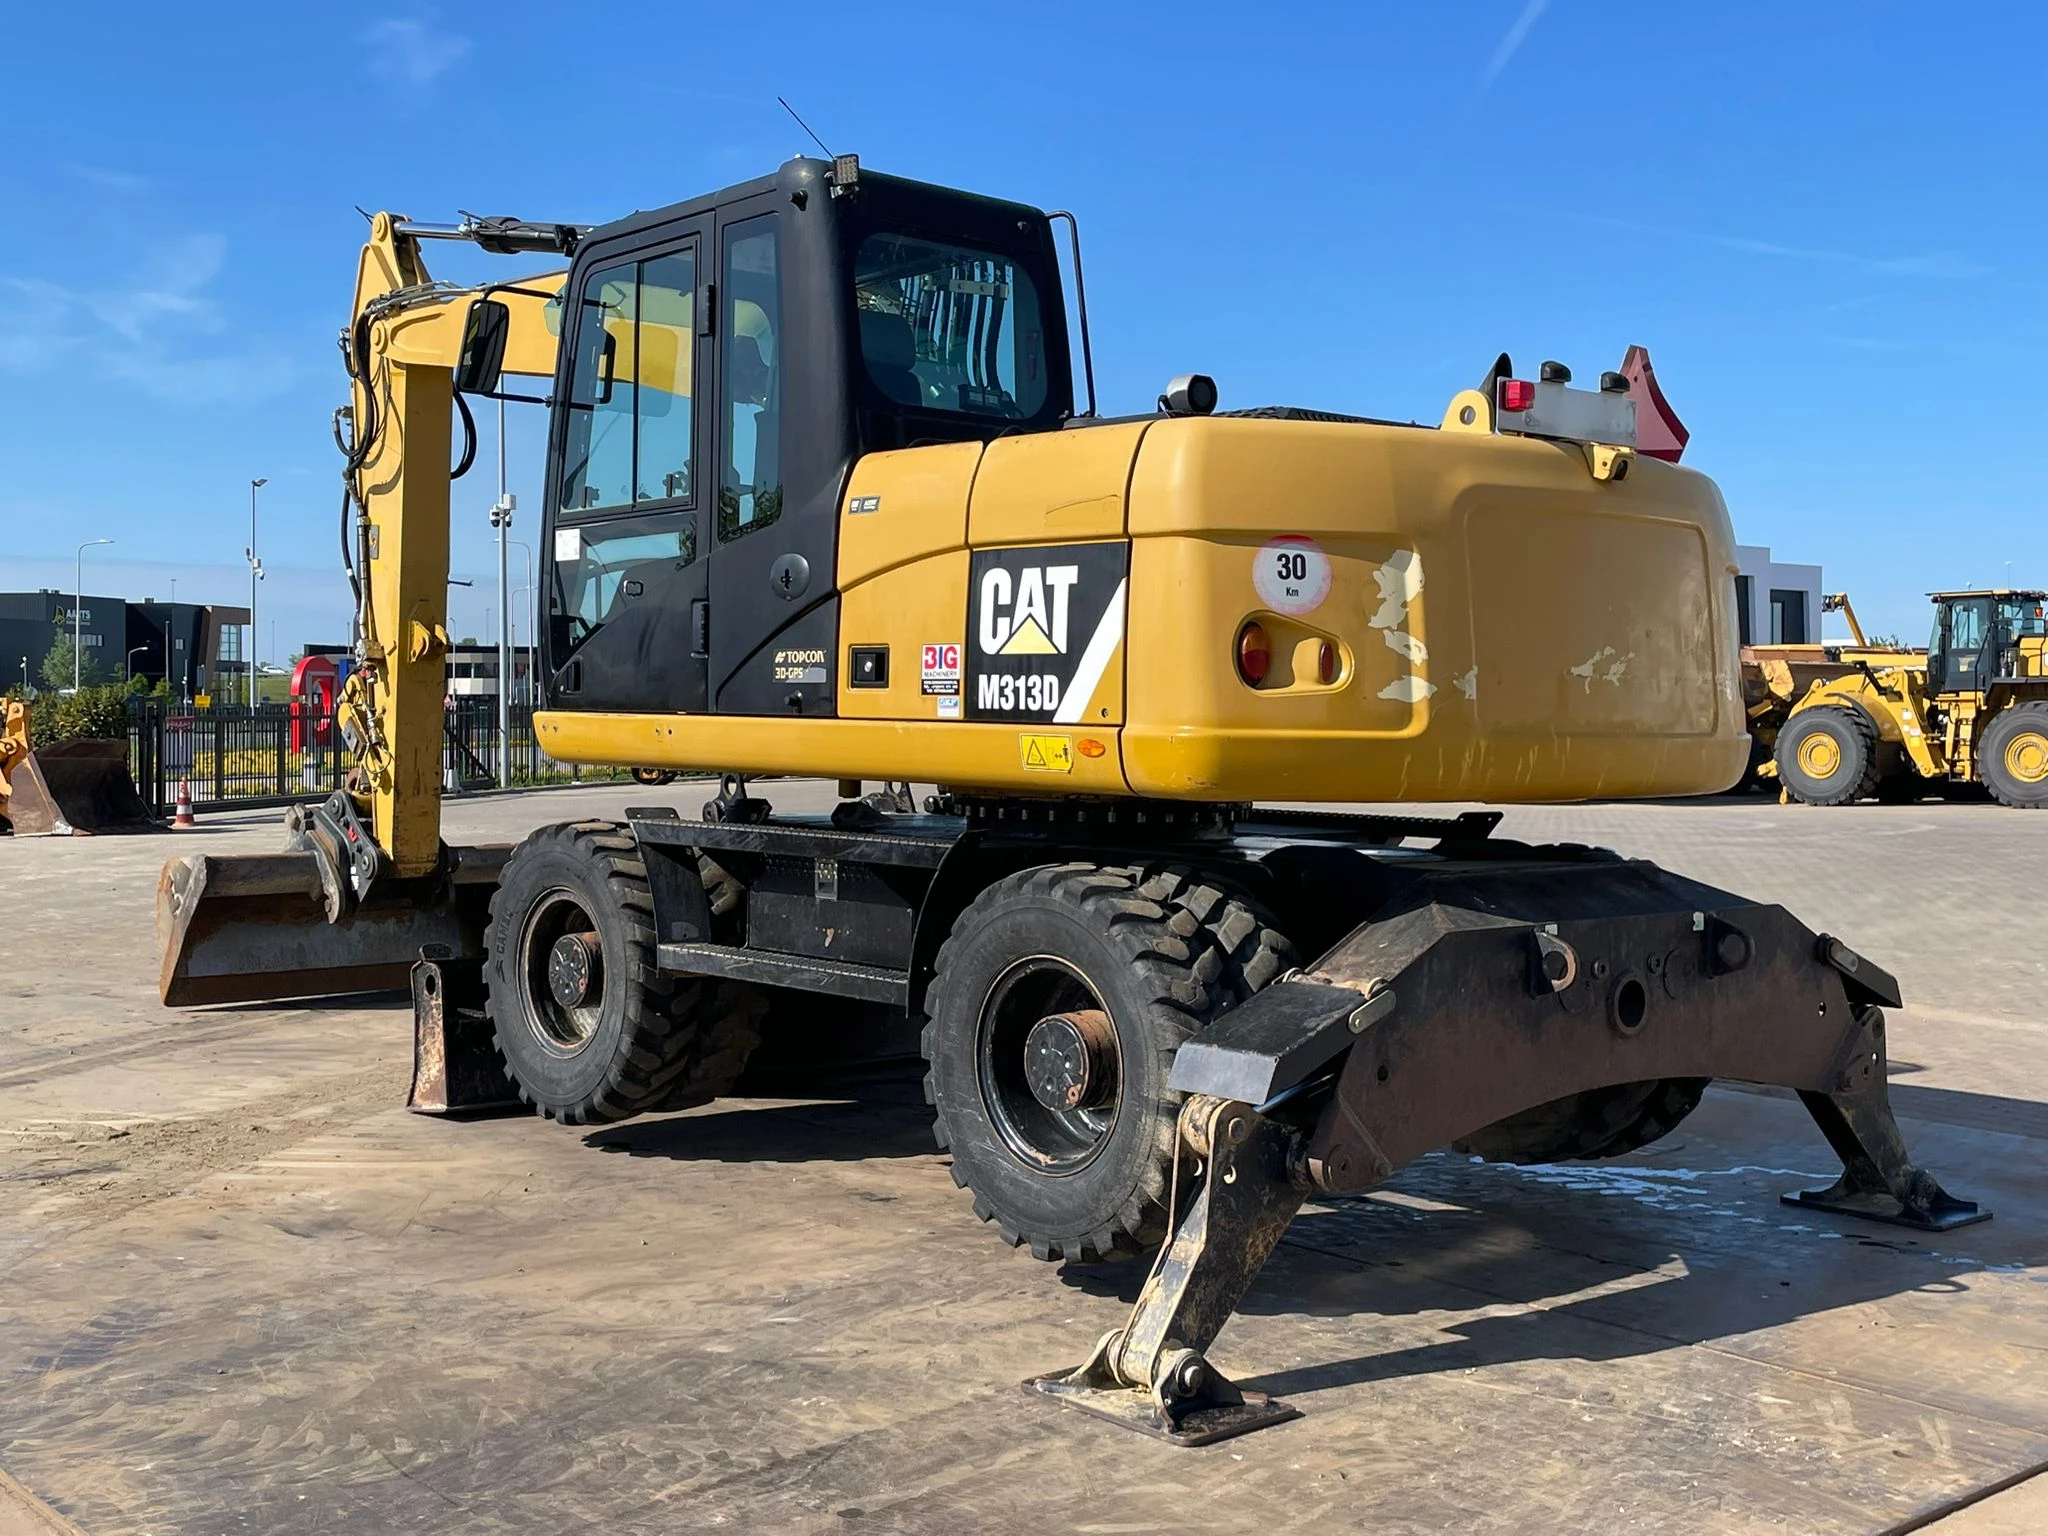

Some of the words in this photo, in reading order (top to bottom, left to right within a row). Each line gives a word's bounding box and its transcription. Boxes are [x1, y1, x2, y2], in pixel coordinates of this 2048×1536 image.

[1276, 553, 1307, 580] 30
[1286, 587, 1299, 597] Km
[66, 608, 91, 619] AATS
[979, 565, 1079, 655] CAT
[786, 650, 825, 663] TOPCON
[775, 667, 804, 679] 3D-GPS
[978, 674, 1060, 711] M313D
